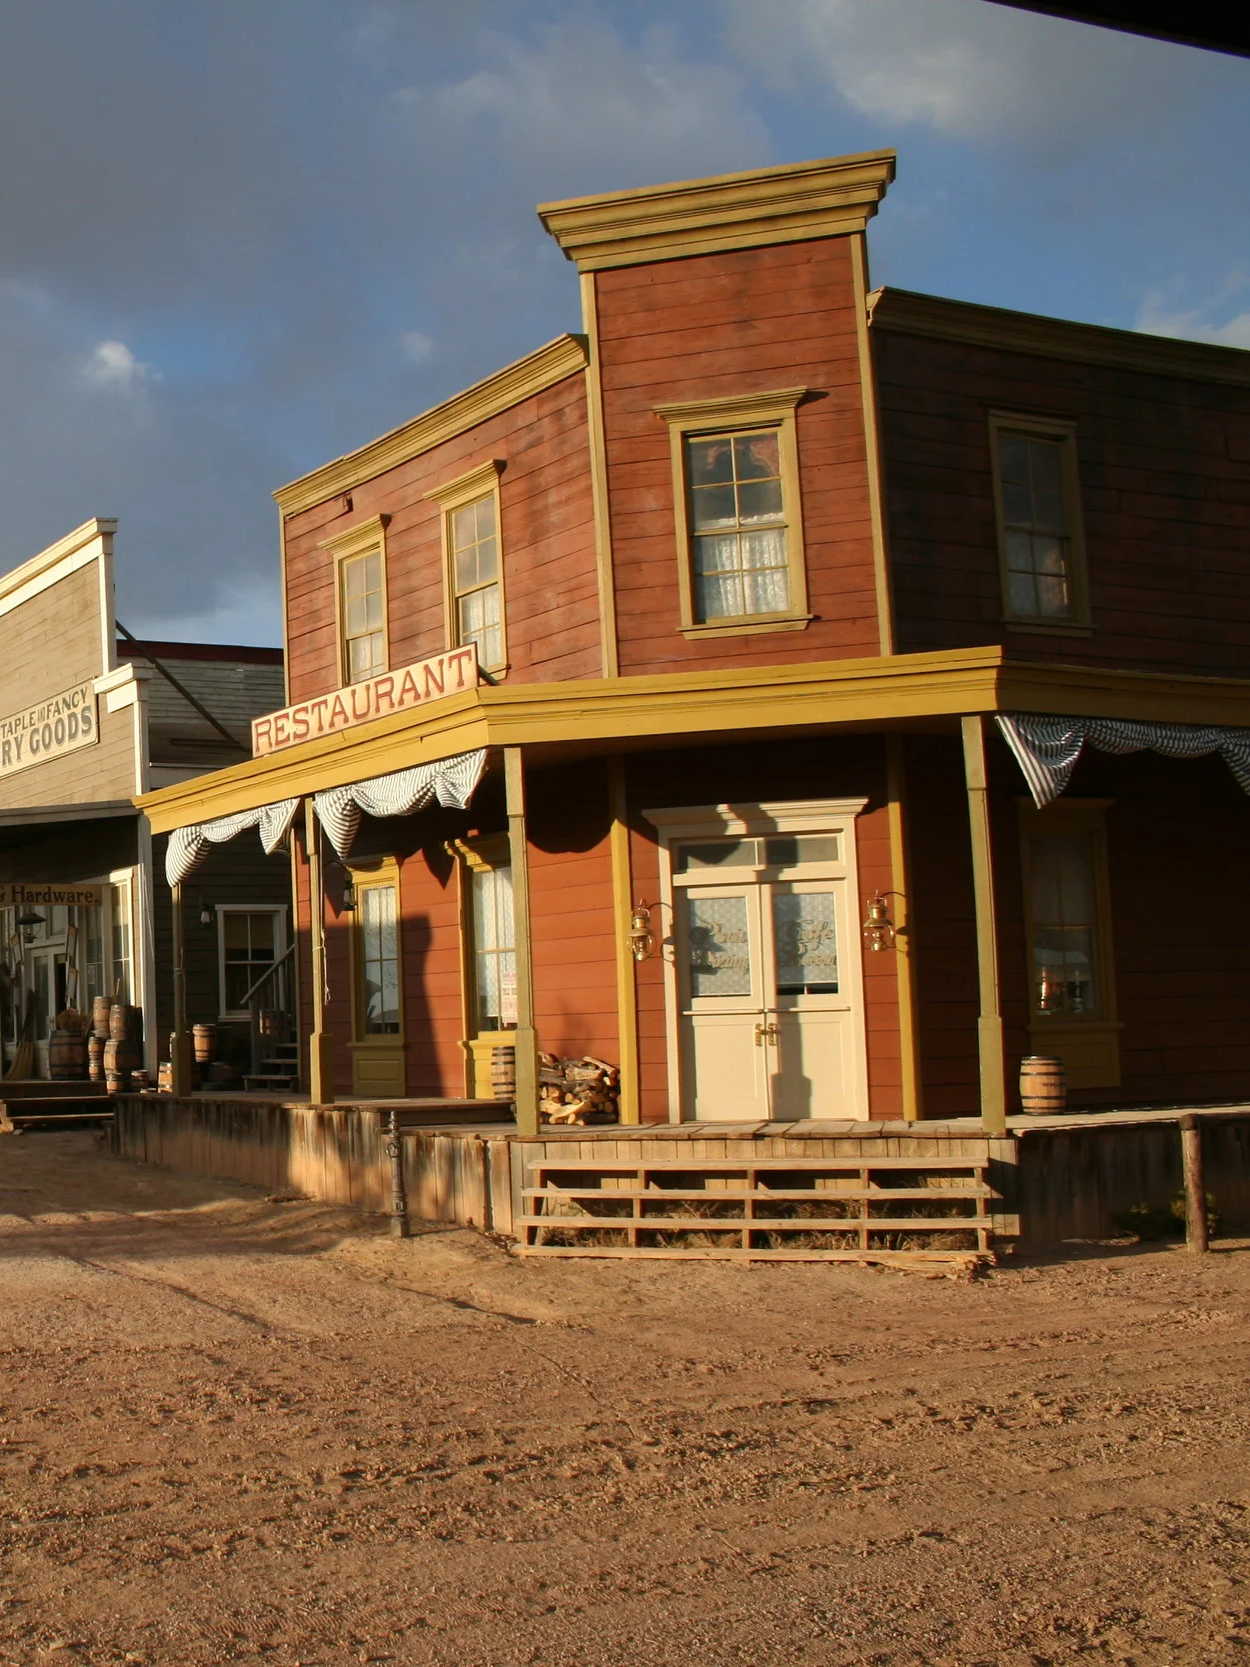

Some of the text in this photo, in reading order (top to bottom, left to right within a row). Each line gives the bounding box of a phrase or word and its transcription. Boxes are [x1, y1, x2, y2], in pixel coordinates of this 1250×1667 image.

[46, 686, 88, 720] FANCY
[254, 650, 472, 752] RESTAURANT
[29, 705, 93, 756] GOODS
[11, 885, 99, 903] Hardware.
